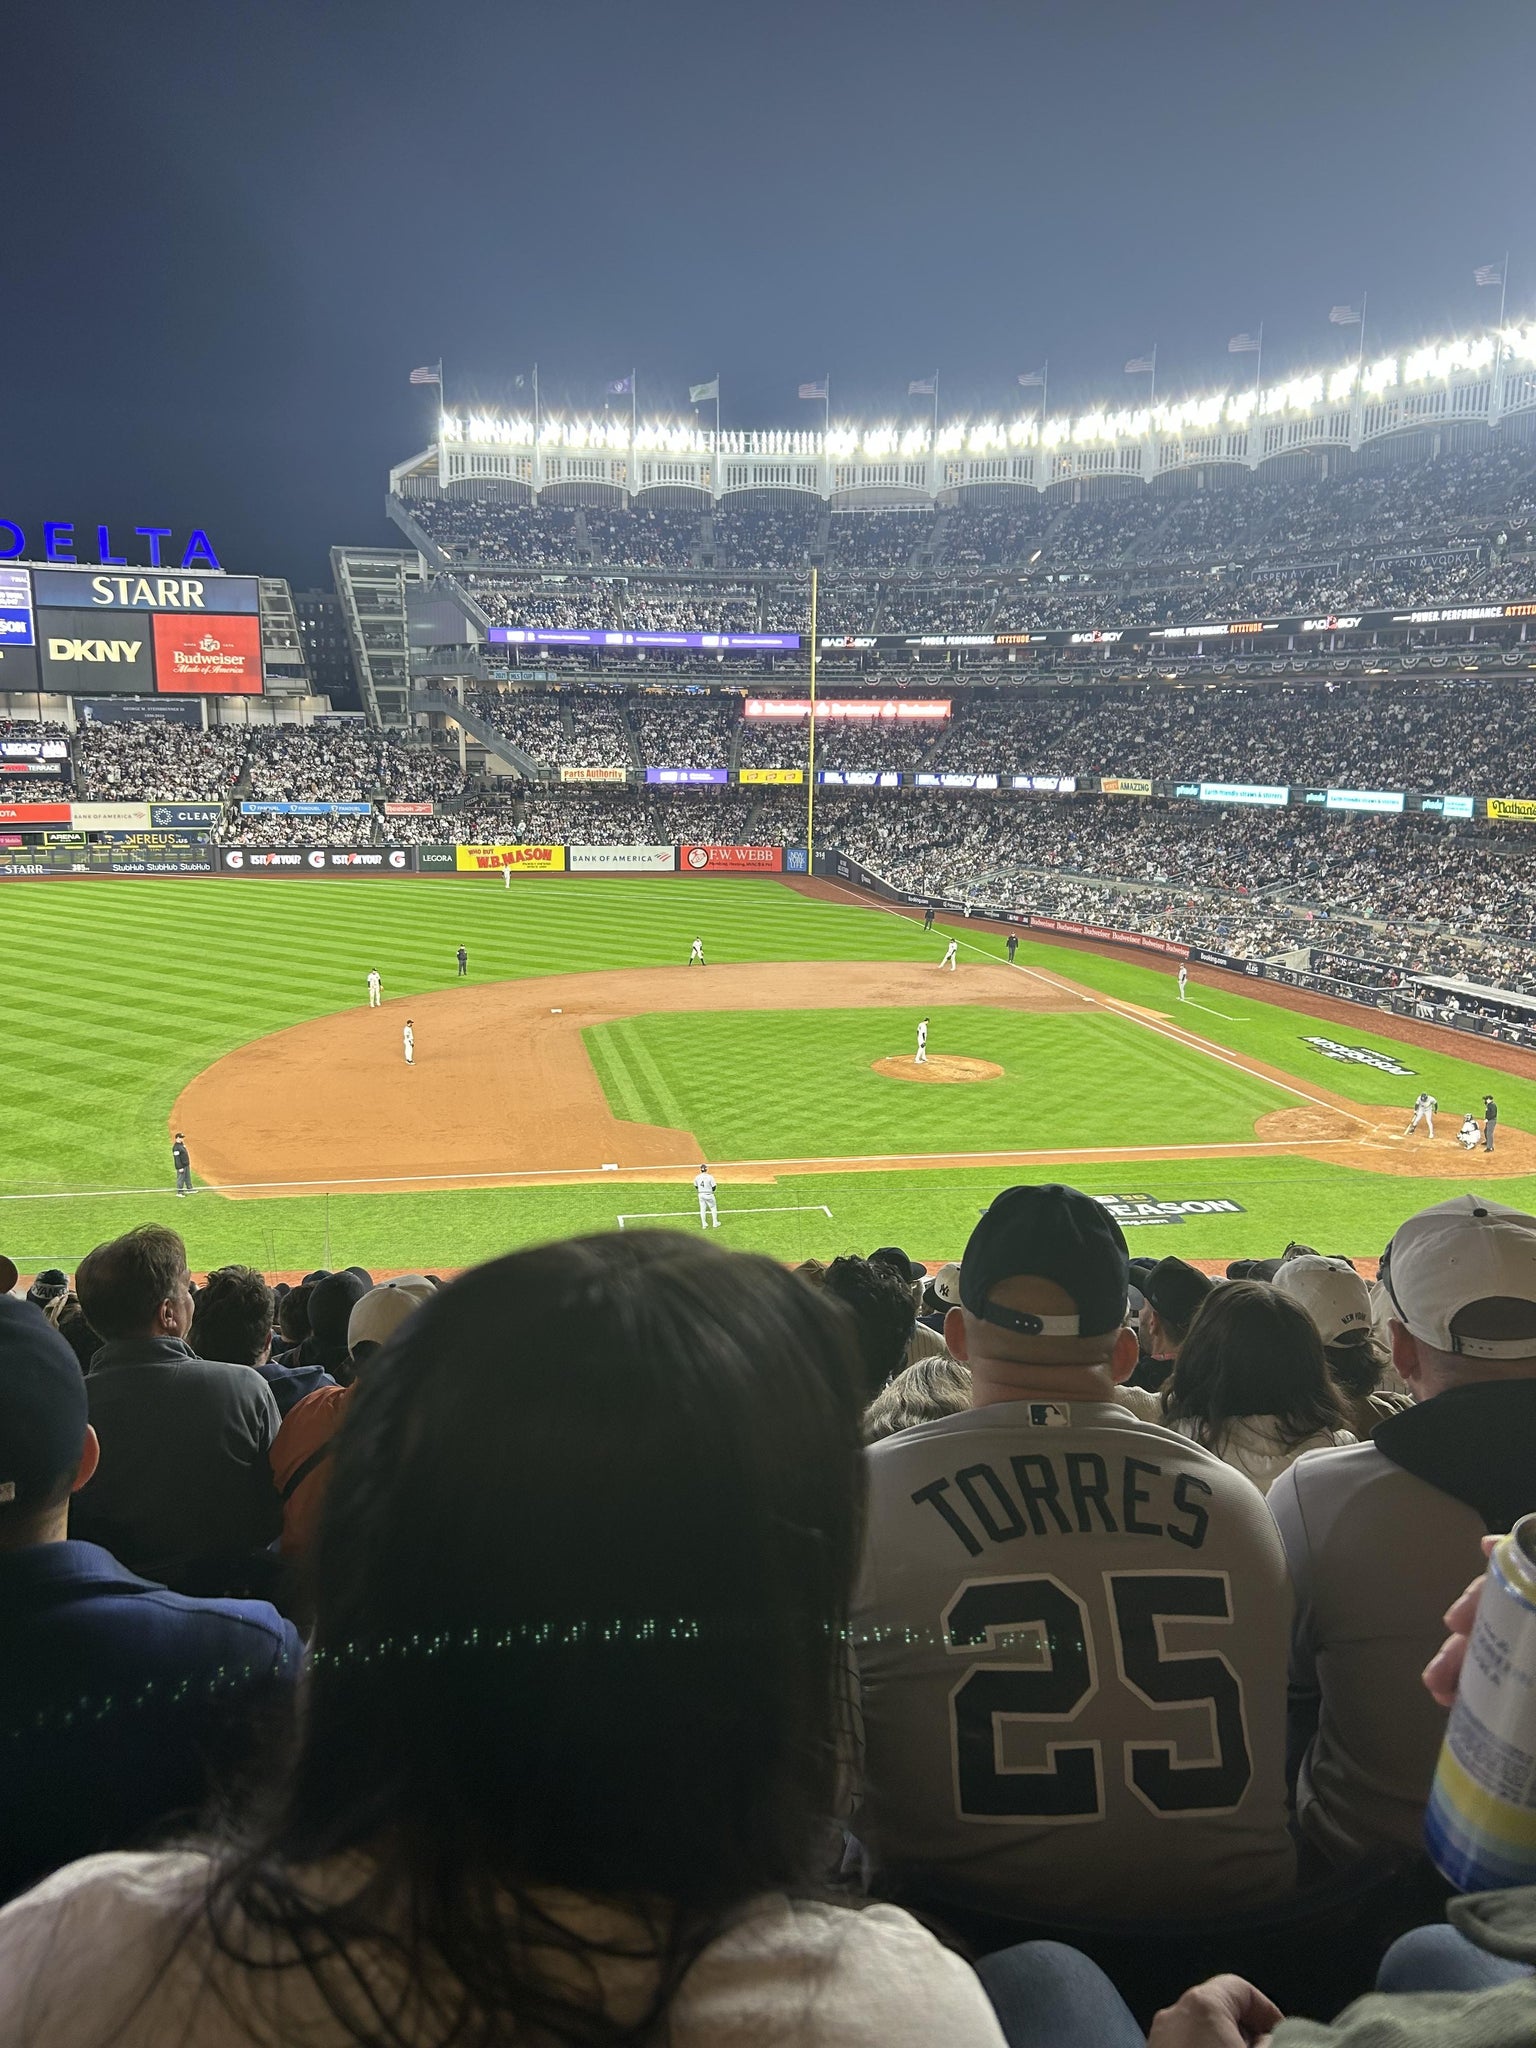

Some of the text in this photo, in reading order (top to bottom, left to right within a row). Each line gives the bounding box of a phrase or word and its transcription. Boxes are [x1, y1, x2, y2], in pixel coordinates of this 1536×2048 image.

[0, 519, 222, 569] DELTA
[1431, 553, 1470, 566] VODKA
[1256, 572, 1288, 582] ASPEN
[92, 577, 205, 607] STARR
[48, 638, 143, 663] DKNY
[173, 650, 245, 665] Budweiser
[564, 769, 623, 779] Parts Authority
[1120, 782, 1150, 792] AMAZING
[178, 812, 217, 821] CLEAR
[226, 851, 244, 868] G
[308, 851, 326, 868] G
[389, 851, 406, 868] G
[422, 854, 453, 862] LEGORA
[709, 849, 774, 861] F.W. WEBB
[5, 864, 43, 874] STARR
[147, 863, 178, 871] StubHub
[180, 862, 211, 871] StubHub
[1030, 916, 1056, 929] Budweiser
[1056, 921, 1083, 934] Budweiser
[1083, 926, 1111, 939] Budweiser
[1112, 932, 1141, 945] Budweiser
[1142, 937, 1165, 951] Budweiser
[1166, 943, 1190, 957] Budweiser
[1200, 952, 1227, 966] Booking.com
[1104, 1200, 1241, 1217] EASON
[939, 1283, 950, 1298] NY
[911, 1451, 1213, 1558] TORRES
[939, 1568, 1255, 1825] 25
